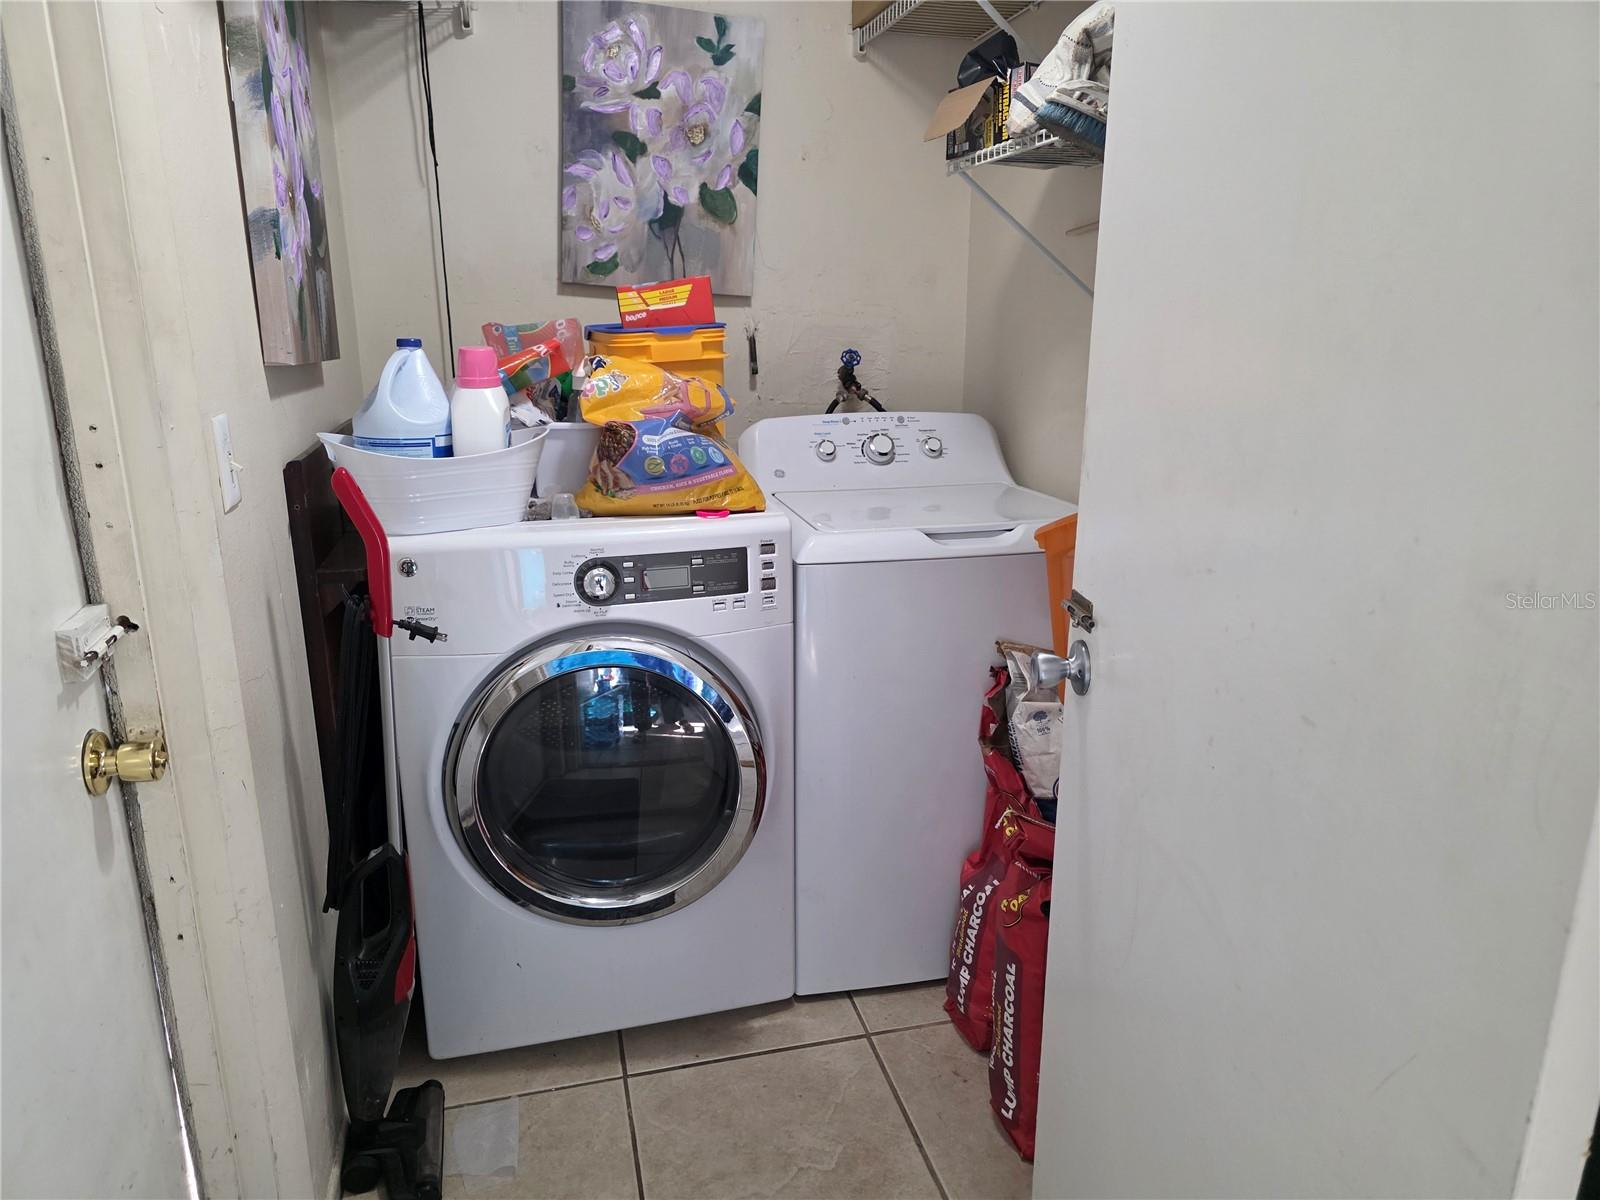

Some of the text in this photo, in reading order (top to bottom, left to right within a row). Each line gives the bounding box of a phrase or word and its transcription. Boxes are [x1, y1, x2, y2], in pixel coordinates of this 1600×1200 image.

[625, 311, 647, 322] bounce
[957, 965, 971, 1015] LUMP
[1001, 962, 1017, 1121] LUMP CHARCOAL
